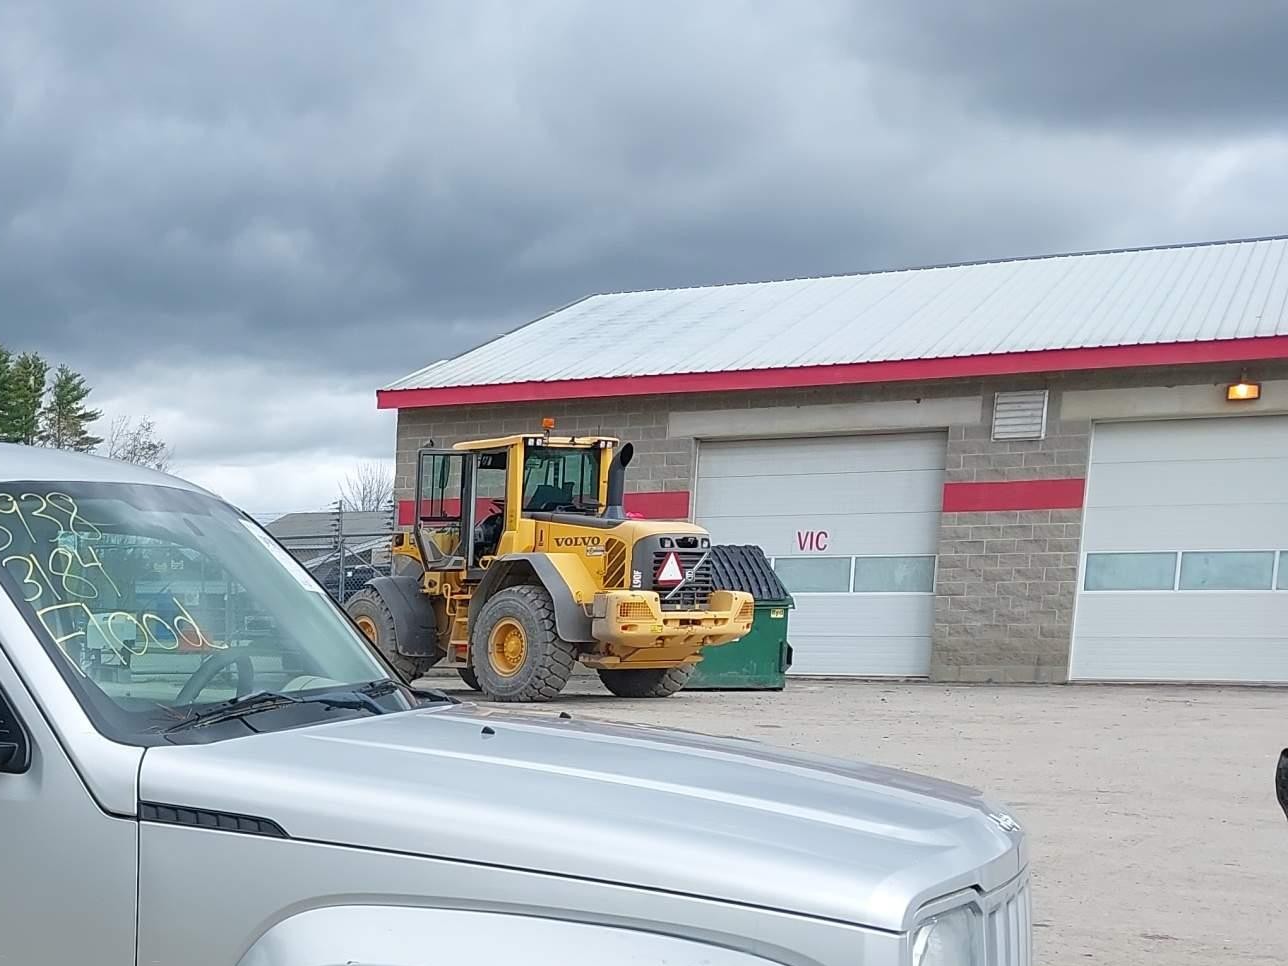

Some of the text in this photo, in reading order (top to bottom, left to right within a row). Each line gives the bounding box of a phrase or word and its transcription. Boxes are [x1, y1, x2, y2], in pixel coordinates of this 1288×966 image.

[554, 536, 601, 547] VOLVO
[797, 531, 829, 551] VIC
[2, 545, 121, 602] 3184
[632, 569, 643, 588] L90F
[36, 597, 229, 679] Flood
